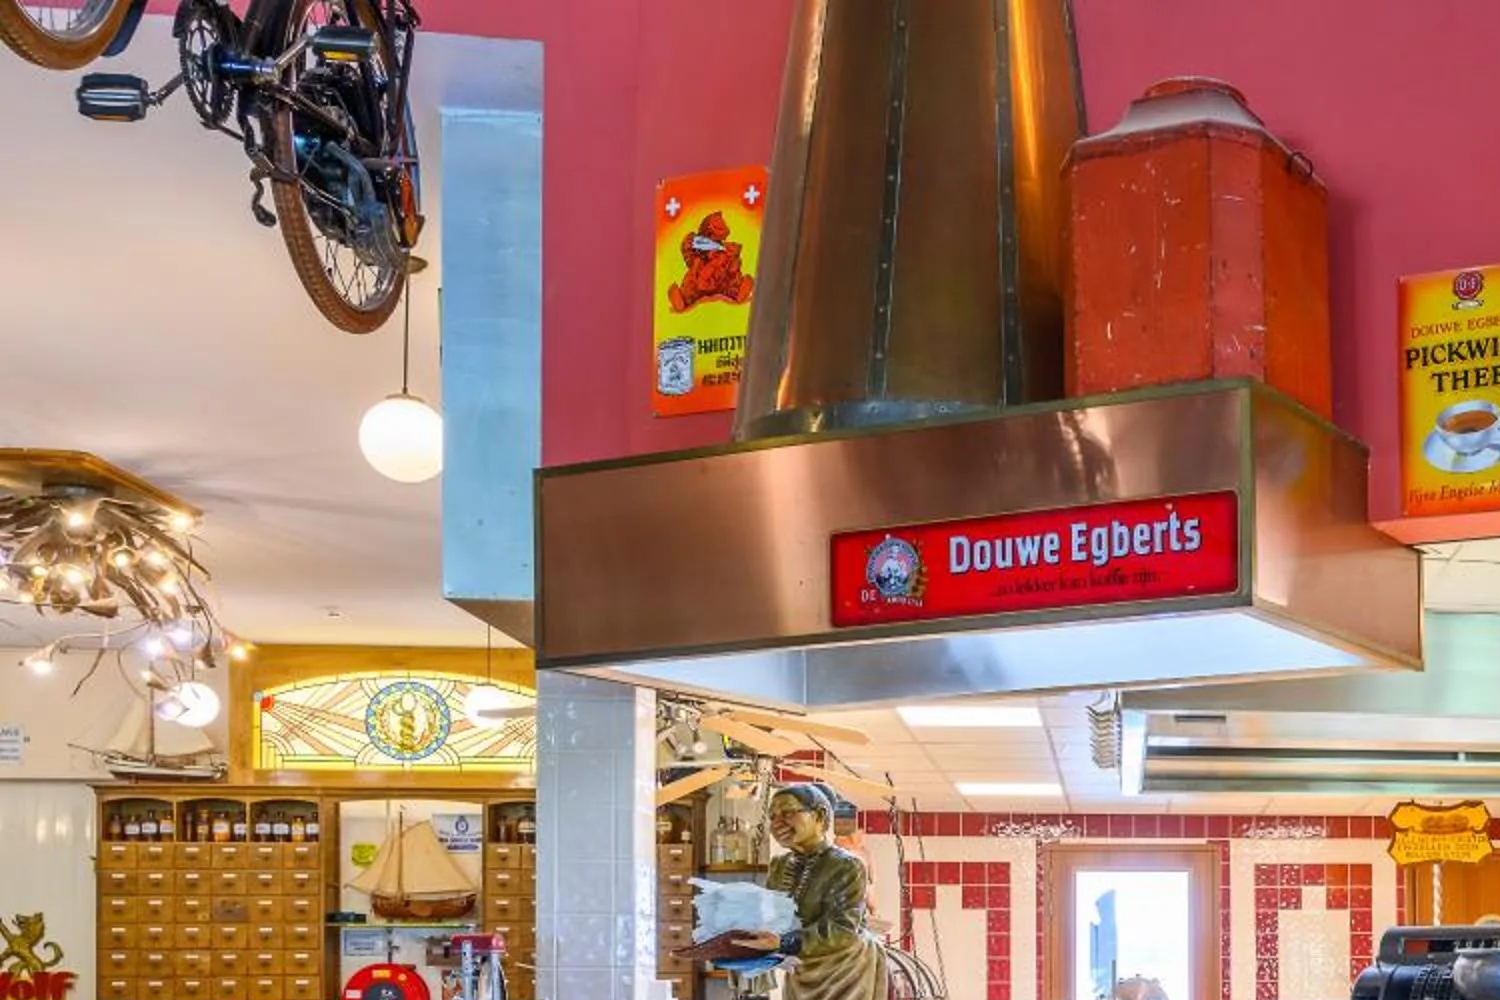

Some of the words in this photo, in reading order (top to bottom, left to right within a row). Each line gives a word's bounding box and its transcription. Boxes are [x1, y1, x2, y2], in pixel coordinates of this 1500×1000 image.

[1411, 321, 1463, 340] DOUWE
[948, 530, 1062, 576] Douwe
[1069, 509, 1202, 565] Egberts
